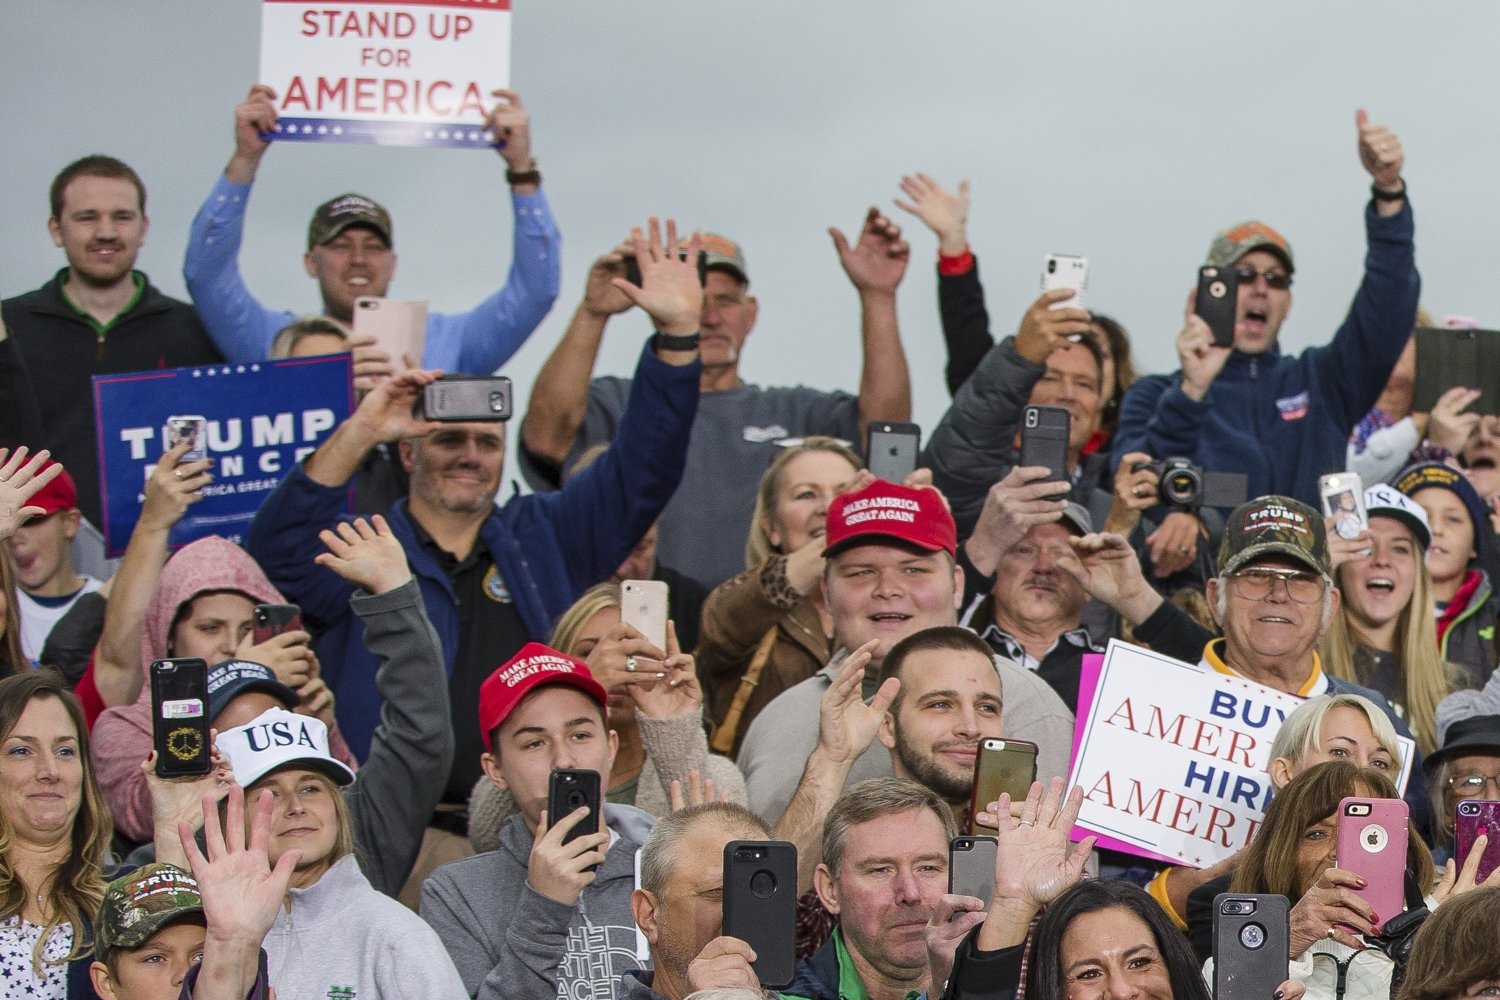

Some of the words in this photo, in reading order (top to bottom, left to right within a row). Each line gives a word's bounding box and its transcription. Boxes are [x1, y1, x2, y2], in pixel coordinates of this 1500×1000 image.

[302, 10, 416, 40] STAND
[429, 14, 473, 41] UP
[361, 49, 411, 68] FOR
[281, 76, 490, 118] AMERICA
[868, 497, 921, 512] AMERICA
[845, 509, 878, 526] GREAT
[879, 510, 915, 523] AGAIN
[1250, 509, 1304, 523] TRUMP
[207, 667, 227, 684] AKE
[499, 659, 528, 683] MAKE
[528, 655, 575, 669] AMERICA
[506, 664, 540, 688] GREAT
[541, 663, 573, 674] AGAIN
[242, 721, 318, 752] USA
[137, 874, 197, 889] TRUMP
[566, 926, 607, 952] HE
